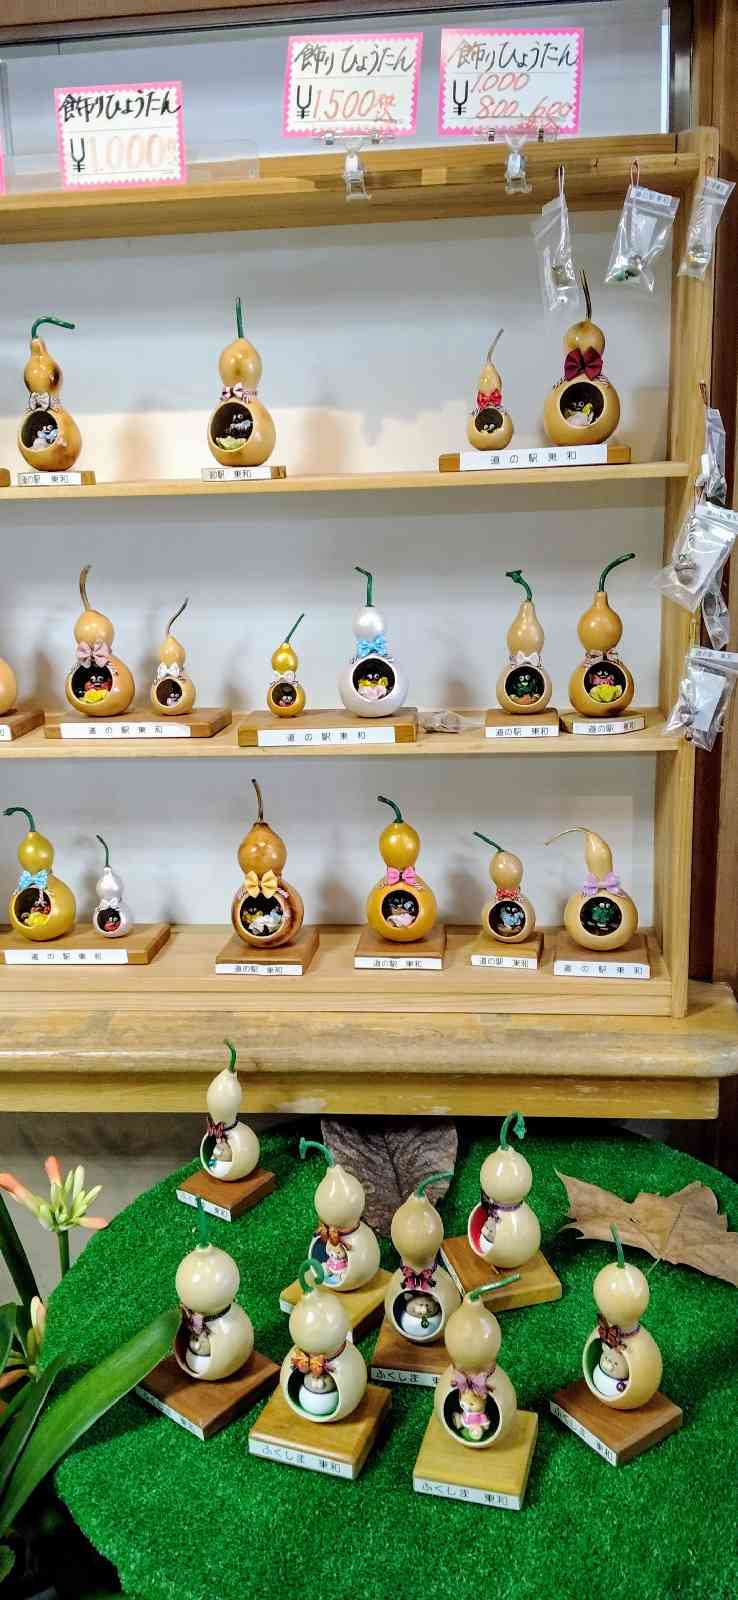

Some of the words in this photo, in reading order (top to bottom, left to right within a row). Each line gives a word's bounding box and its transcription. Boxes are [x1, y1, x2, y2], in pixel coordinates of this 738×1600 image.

[294, 43, 416, 75] 飾りひょうたん
[448, 40, 577, 72] 飾りひょうたん
[58, 90, 181, 122] 飾りひょうたん
